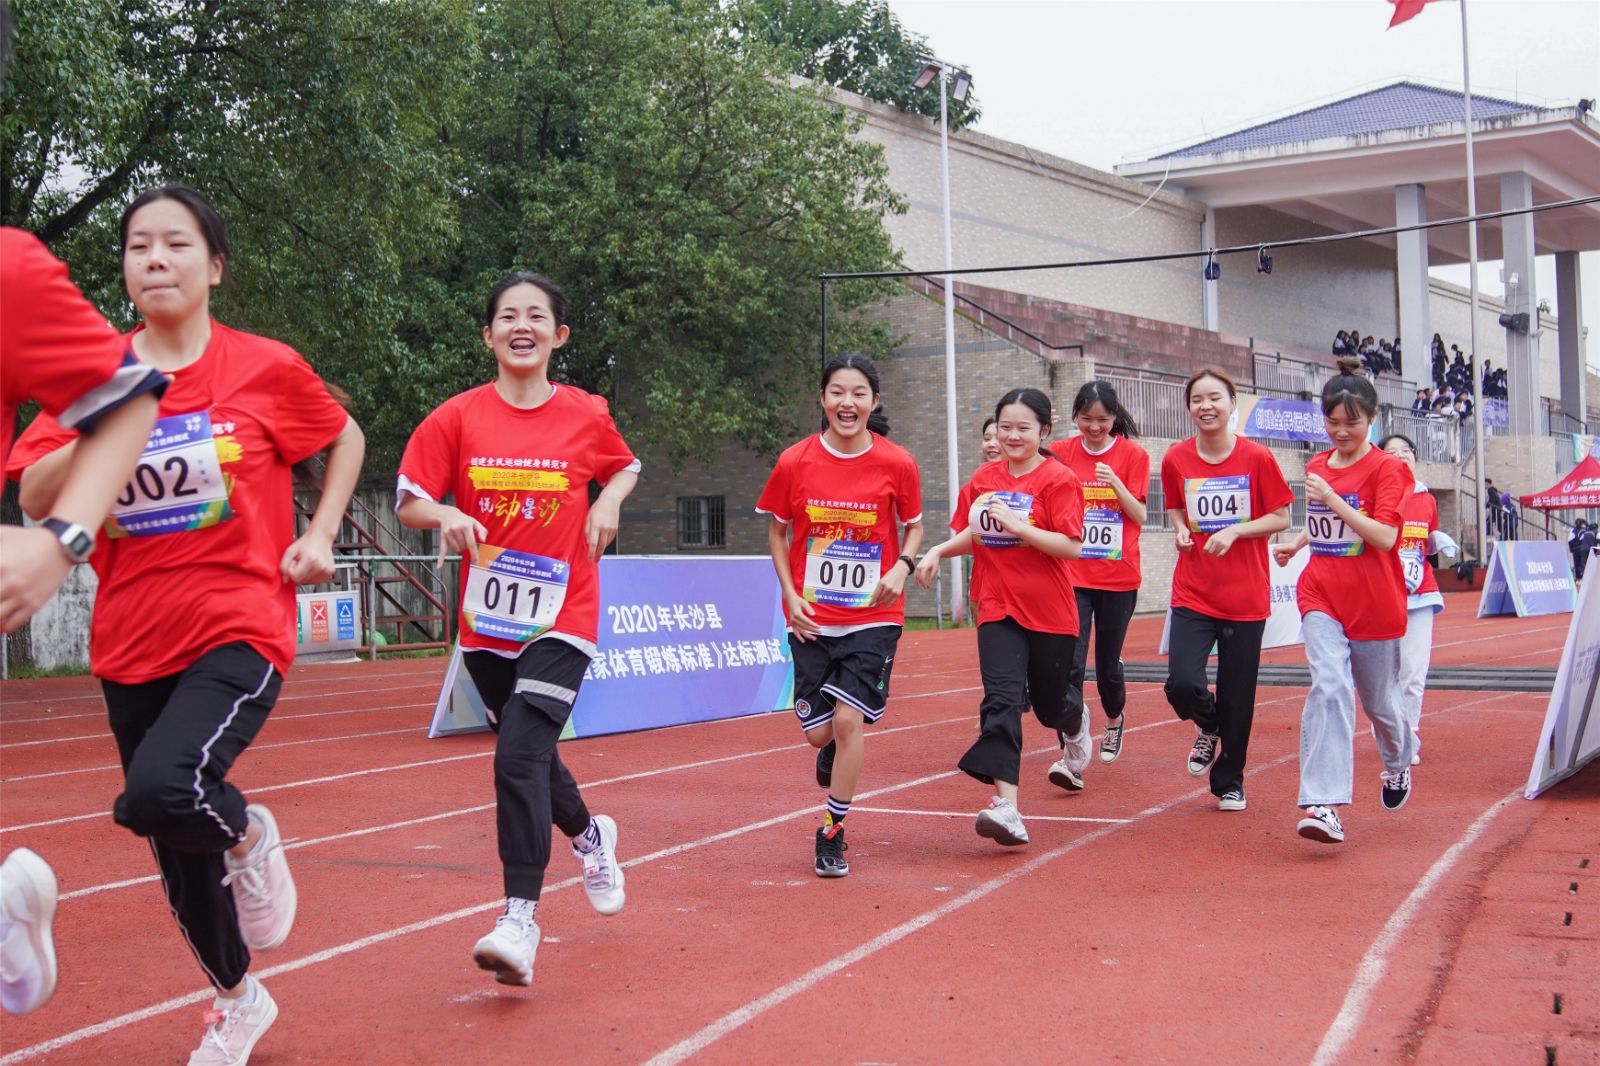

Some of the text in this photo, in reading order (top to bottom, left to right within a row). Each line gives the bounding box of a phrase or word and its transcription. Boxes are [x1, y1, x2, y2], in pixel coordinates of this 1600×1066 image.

[479, 492, 560, 528] 悦动星沙
[1198, 494, 1238, 517] 004
[1308, 516, 1345, 539] 007
[820, 561, 865, 588] 010
[1402, 561, 1419, 581] 73
[484, 577, 542, 619] 011
[607, 603, 723, 634] 2020年长沙县
